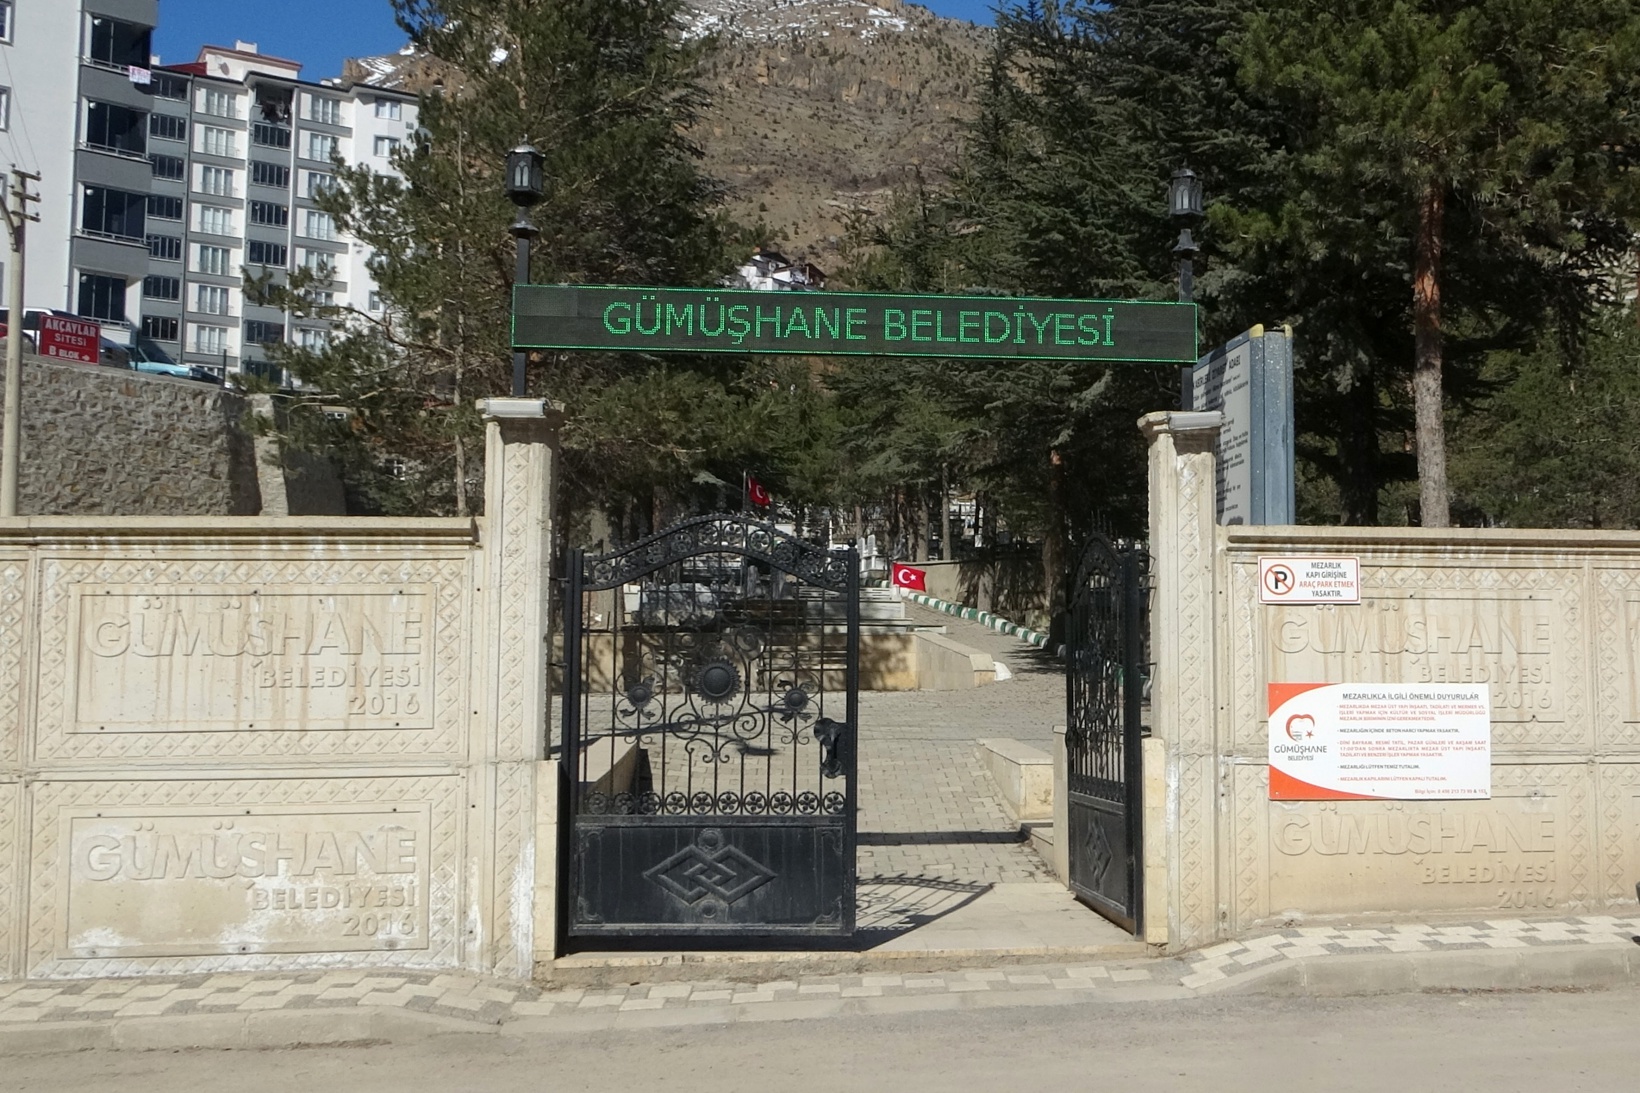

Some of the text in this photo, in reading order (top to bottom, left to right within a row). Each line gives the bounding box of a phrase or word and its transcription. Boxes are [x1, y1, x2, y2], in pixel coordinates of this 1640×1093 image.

[45, 318, 96, 337] AKÇAYLAR
[603, 295, 1115, 346] GÜMÜŞHANE BELEDİYESİ
[48, 345, 80, 360] B BLOK
[1321, 570, 1347, 580] GİRİŞİNE
[84, 600, 422, 668] GÜMÜŞHANE
[1271, 604, 1551, 665] GÜMÜŞHANE
[258, 662, 422, 688] BELEDİYESİ
[1417, 662, 1552, 684] BELEDİYESİ
[348, 694, 420, 716] 2016
[1409, 692, 1435, 700] ÖNEMLİ
[1493, 688, 1553, 710] 2016
[1274, 744, 1327, 754] GÜMÜŞHANE
[1272, 803, 1555, 865] GÜMÜŞHANE
[78, 820, 416, 890] GÜMÜŞHANE
[1422, 860, 1556, 884] BELEDİYESİ
[251, 879, 416, 911] BELEDİYESİ
[1498, 888, 1556, 910] 2016
[342, 913, 414, 936] 2016
